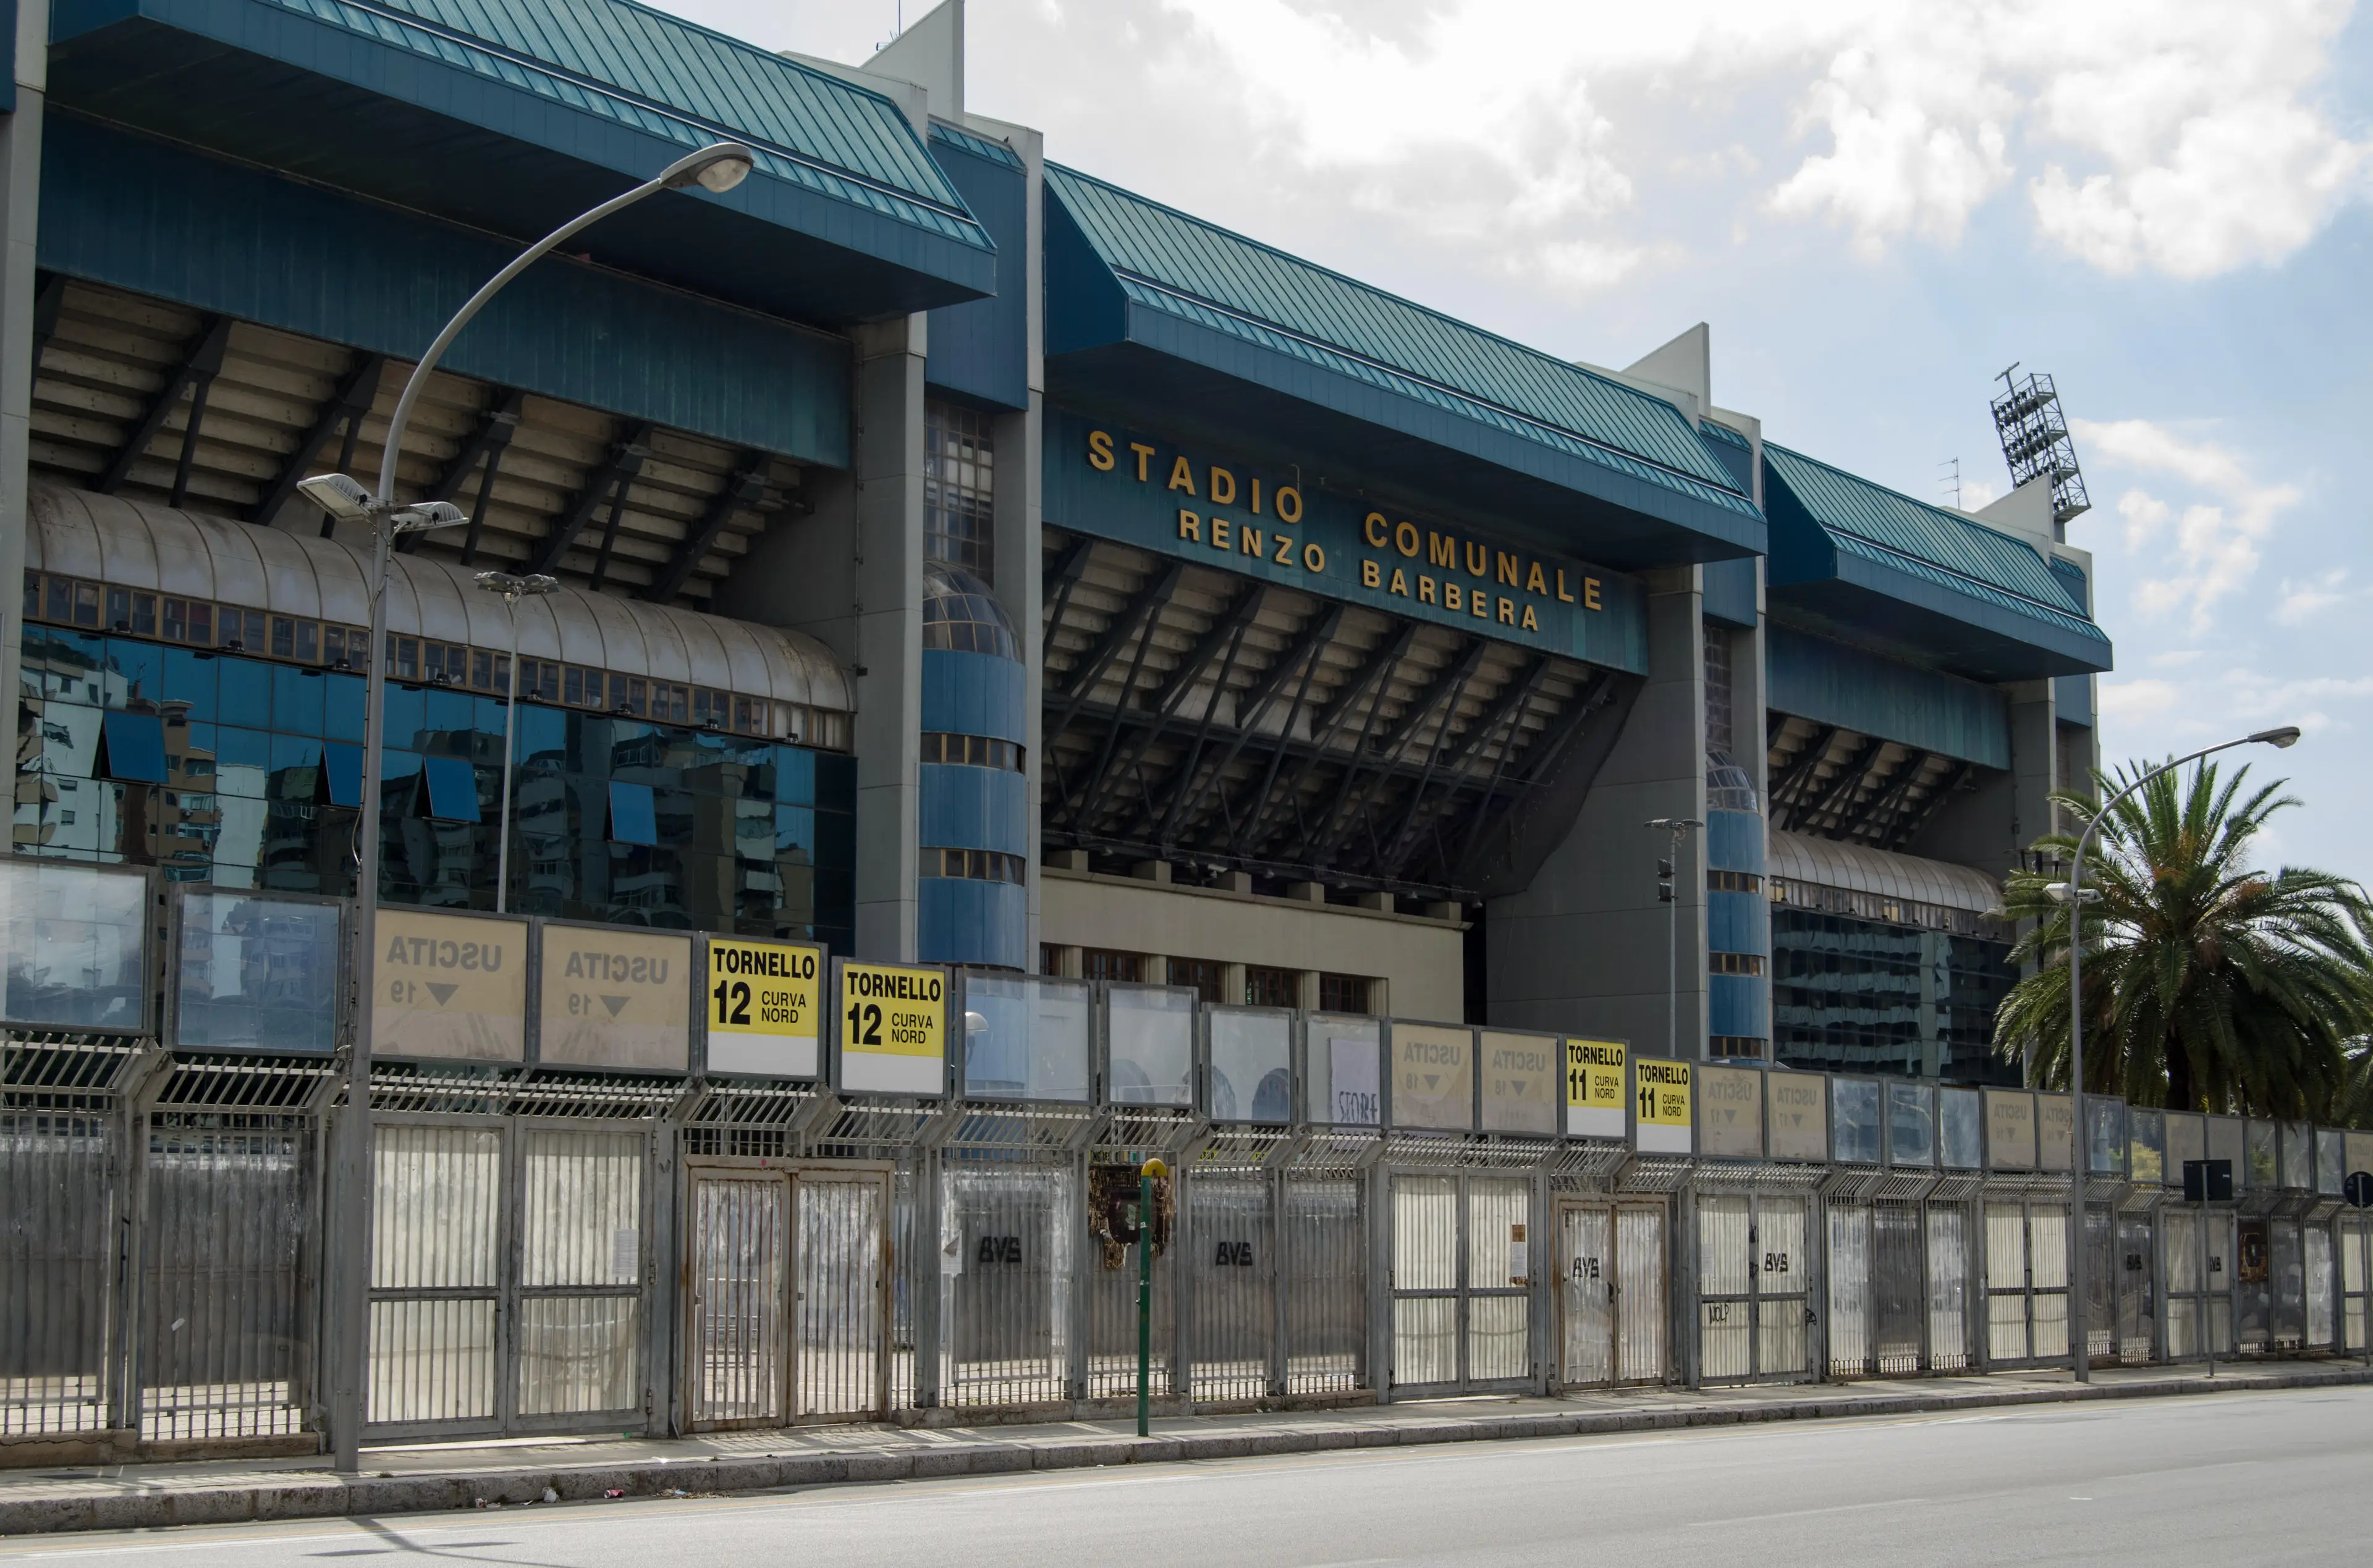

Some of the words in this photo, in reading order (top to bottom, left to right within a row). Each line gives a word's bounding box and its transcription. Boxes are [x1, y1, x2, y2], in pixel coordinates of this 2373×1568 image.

[1089, 430, 1303, 523] STADIO
[1364, 512, 1602, 610] COMUNALE
[1180, 510, 1325, 573] RENZO
[1363, 559, 1539, 631] BARBERA
[713, 947, 815, 980] TORNELLO
[847, 971, 941, 1002] TORNELLO
[714, 980, 751, 1026] 12
[761, 990, 806, 1008] CURVA
[761, 1007, 798, 1024] NORD
[847, 1002, 882, 1046] 12
[892, 1013, 933, 1029] CURVA
[892, 1029, 926, 1044] NORD
[1568, 1045, 1623, 1067] TORNELLO
[1569, 1068, 1586, 1101] 11
[1594, 1075, 1619, 1087] CURVA
[1638, 1064, 1688, 1085] TORNELLO
[1594, 1087, 1615, 1099] NORD
[1639, 1087, 1655, 1118] 11
[1662, 1094, 1685, 1105] CURVA
[1662, 1105, 1682, 1117] NORD
[978, 1236, 1022, 1263] BVS
[1216, 1242, 1253, 1267] BVS
[1764, 1252, 1788, 1273] BVS
